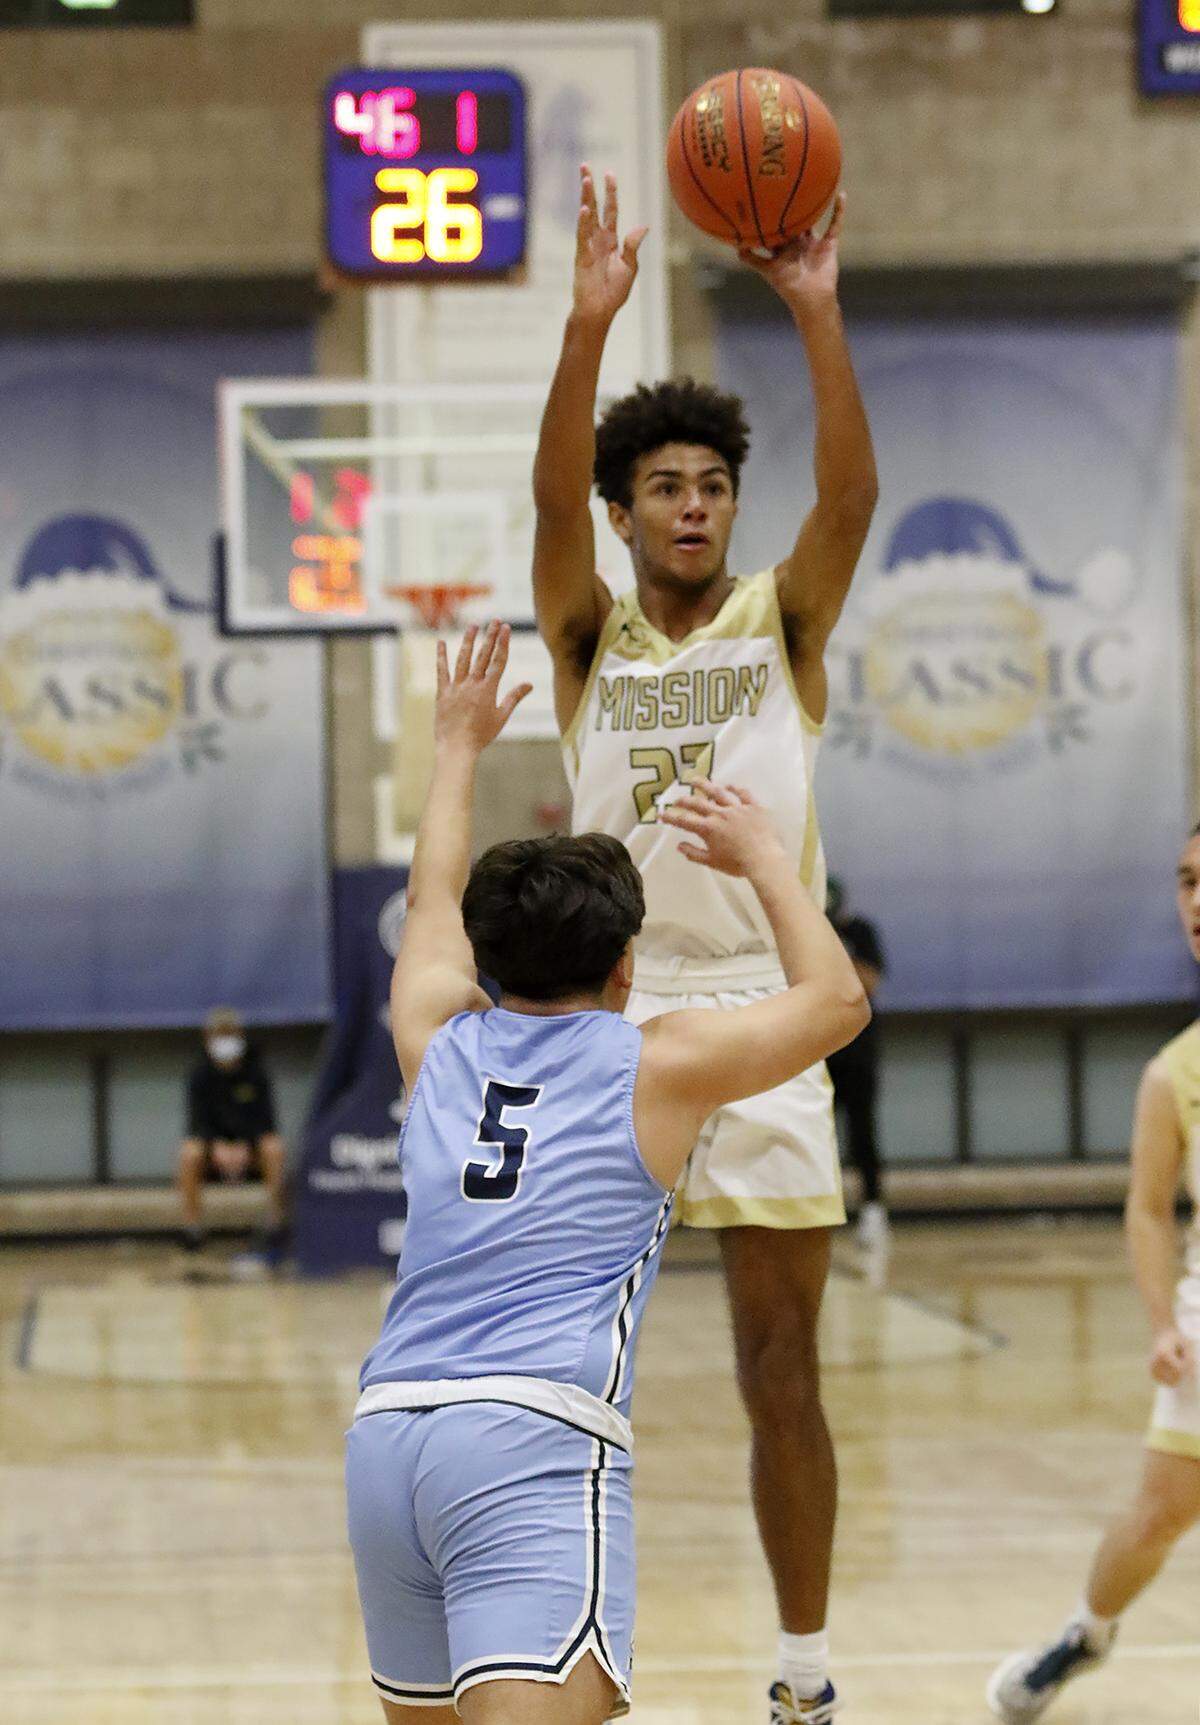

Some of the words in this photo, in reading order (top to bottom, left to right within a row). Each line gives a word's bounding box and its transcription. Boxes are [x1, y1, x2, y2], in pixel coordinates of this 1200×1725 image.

[456, 90, 479, 156] 1
[370, 167, 483, 263] 26
[595, 664, 769, 732] MISSION
[829, 630, 1144, 705] LASSIC
[629, 740, 716, 825] 23
[460, 1079, 545, 1203] 5
